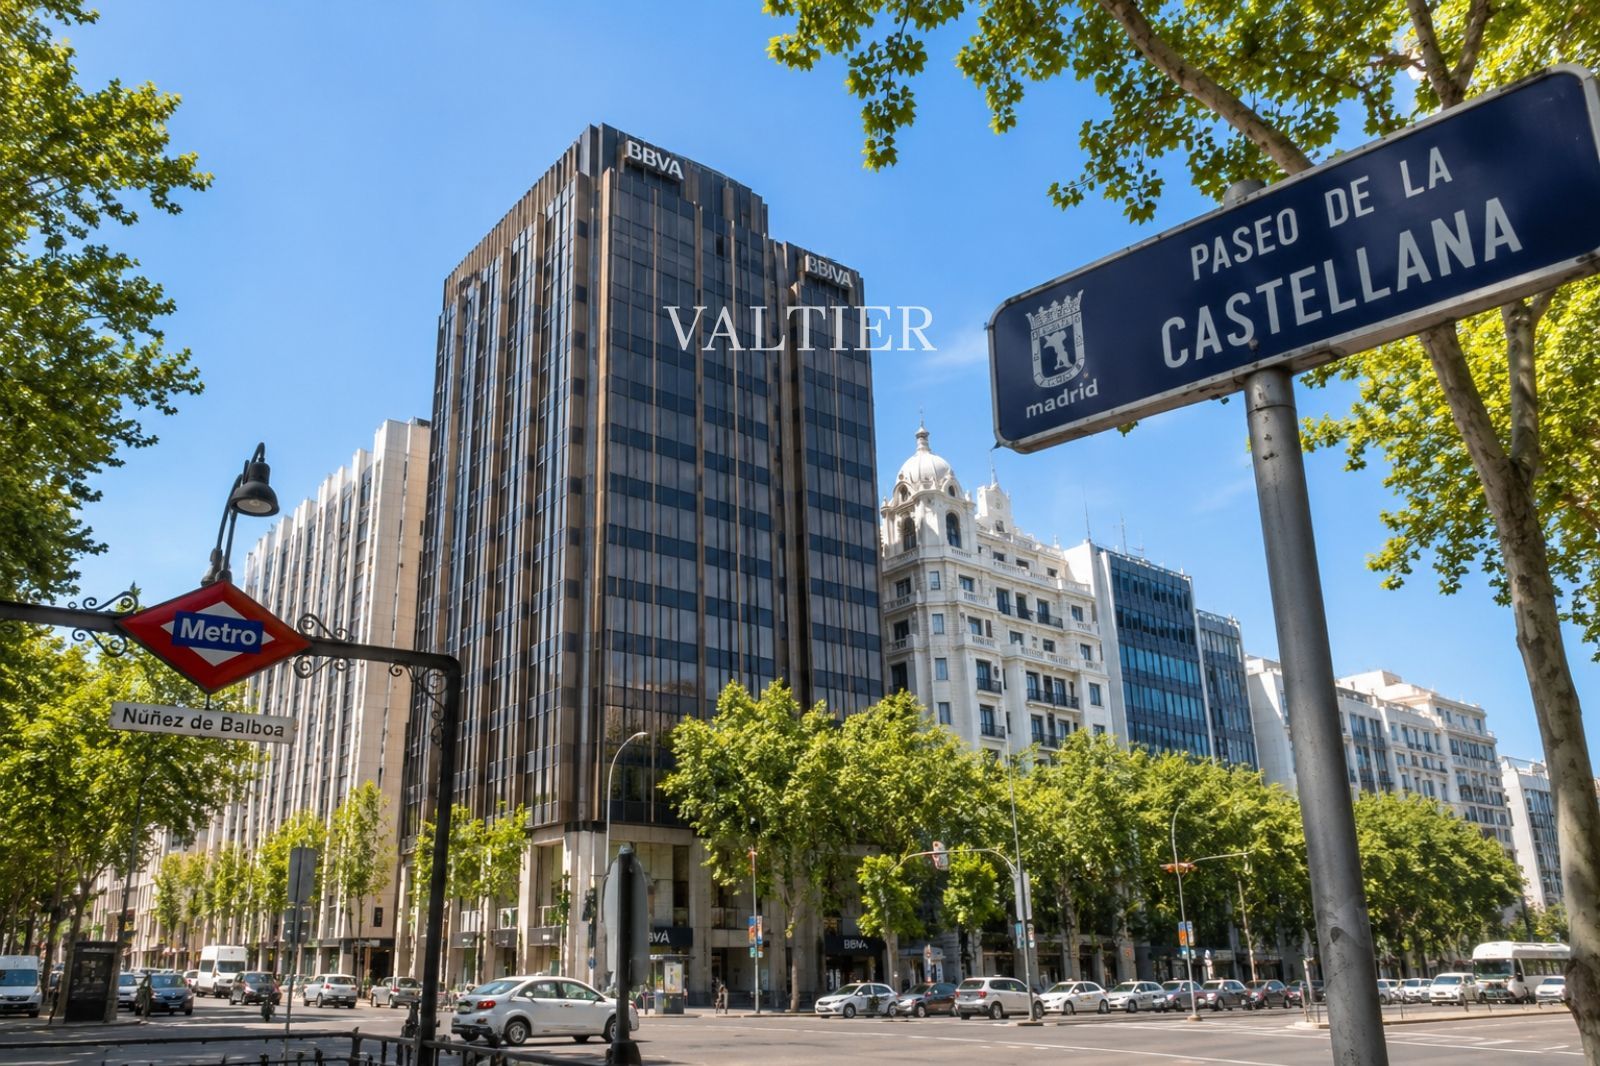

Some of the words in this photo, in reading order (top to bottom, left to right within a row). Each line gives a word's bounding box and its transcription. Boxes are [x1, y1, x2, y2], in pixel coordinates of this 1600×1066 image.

[627, 140, 684, 180] BBVA
[1190, 207, 1299, 281] PASEO
[1324, 175, 1375, 228] DE
[1399, 146, 1453, 199] LA
[1161, 197, 1523, 369] CASTELLANA
[1026, 378, 1099, 418] madrid
[180, 617, 257, 646] Metro
[122, 707, 184, 728] Núñez
[190, 714, 213, 731] de
[220, 716, 285, 737] Balboa
